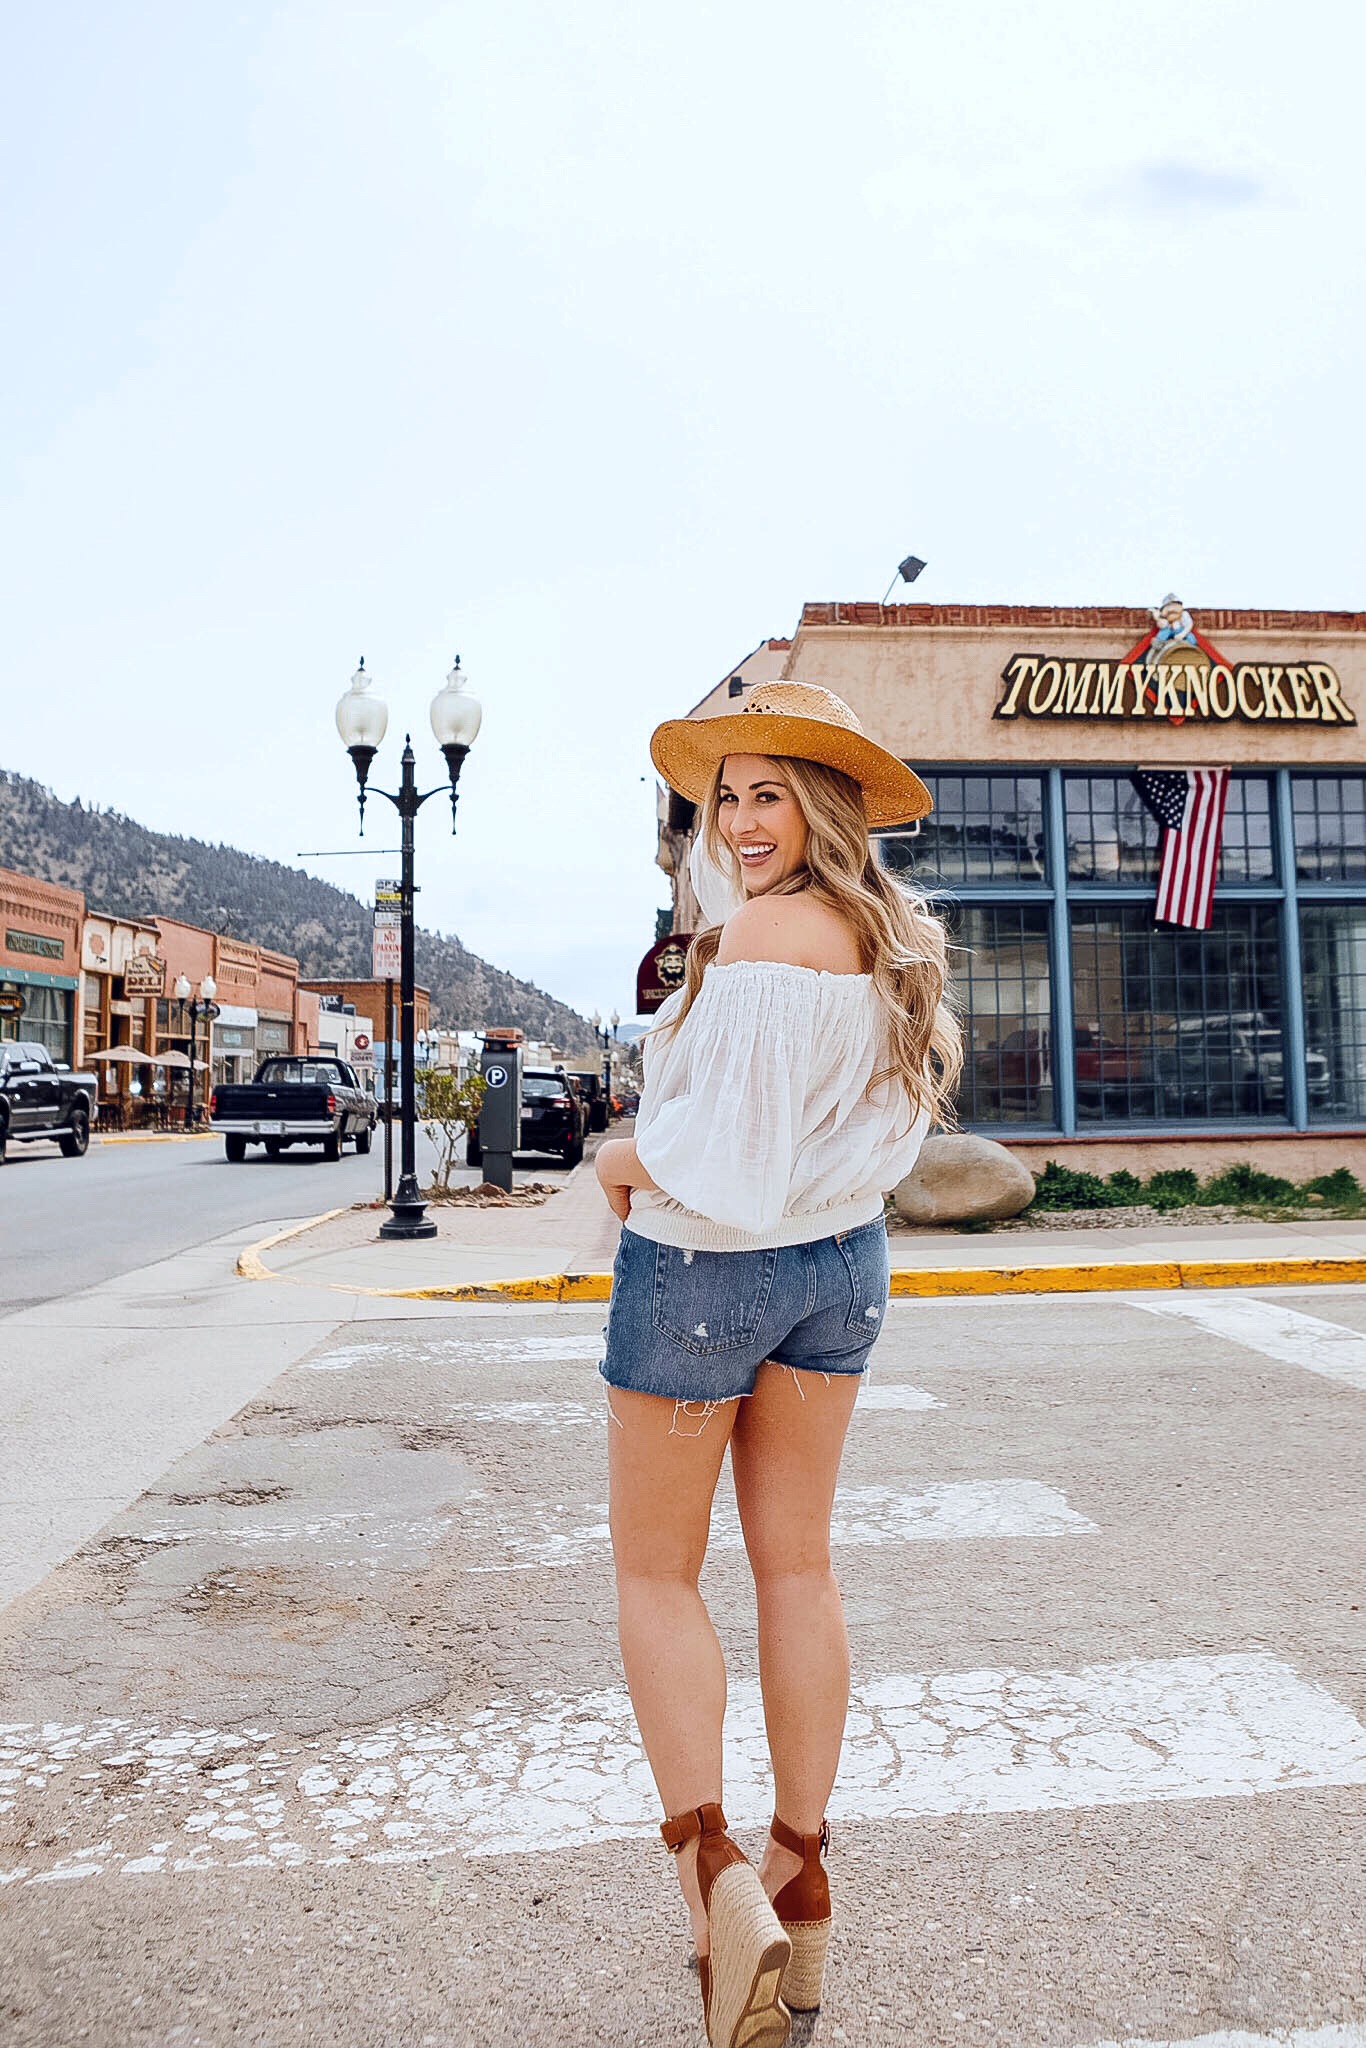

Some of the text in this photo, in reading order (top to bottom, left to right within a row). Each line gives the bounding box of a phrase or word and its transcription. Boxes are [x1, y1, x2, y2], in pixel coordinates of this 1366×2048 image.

[999, 657, 1354, 721] TOMMYKNOCKER
[384, 932, 396, 942] NO
[375, 944, 401, 952] PARKIN
[127, 976, 162, 986] DELI
[492, 1070, 503, 1084] P
